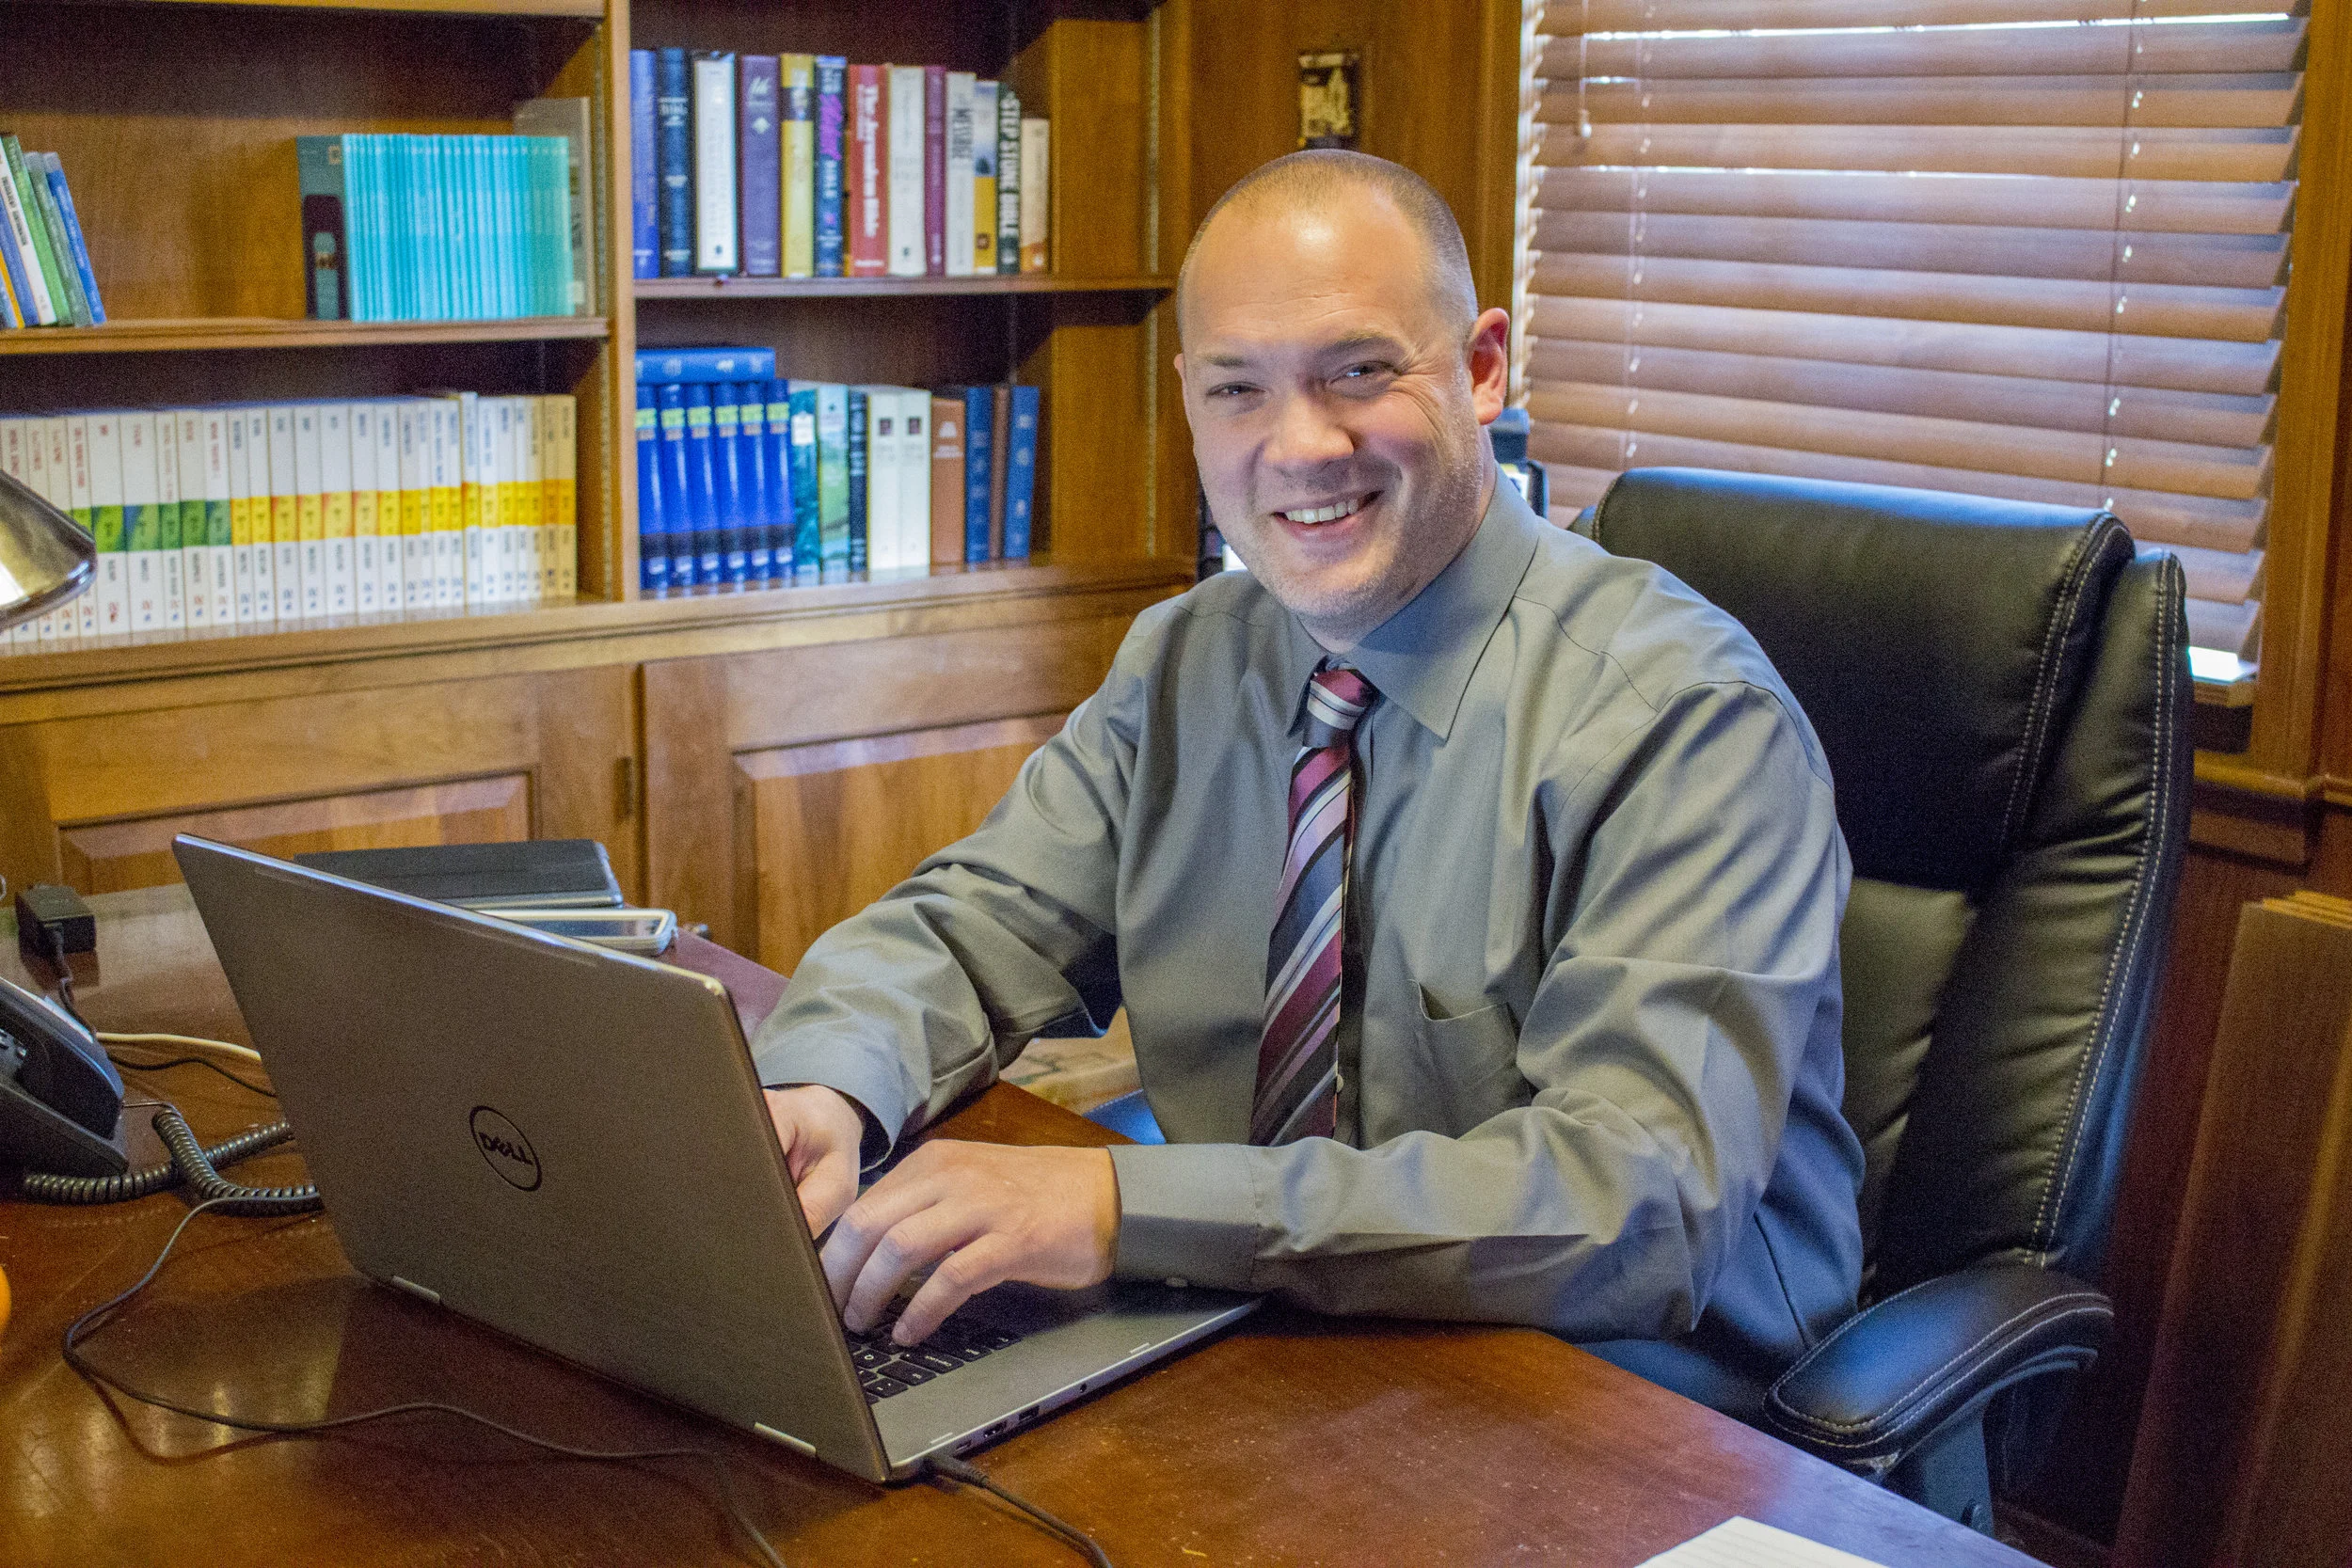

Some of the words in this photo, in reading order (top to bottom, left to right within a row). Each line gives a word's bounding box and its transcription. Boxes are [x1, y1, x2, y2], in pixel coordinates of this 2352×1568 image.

[864, 84, 879, 115] The
[952, 107, 973, 159] MESSAGE
[864, 120, 880, 197] Jerusalem
[864, 198, 880, 238] Bible
[998, 192, 1020, 237] BIBLE
[478, 1132, 533, 1165] DELL
